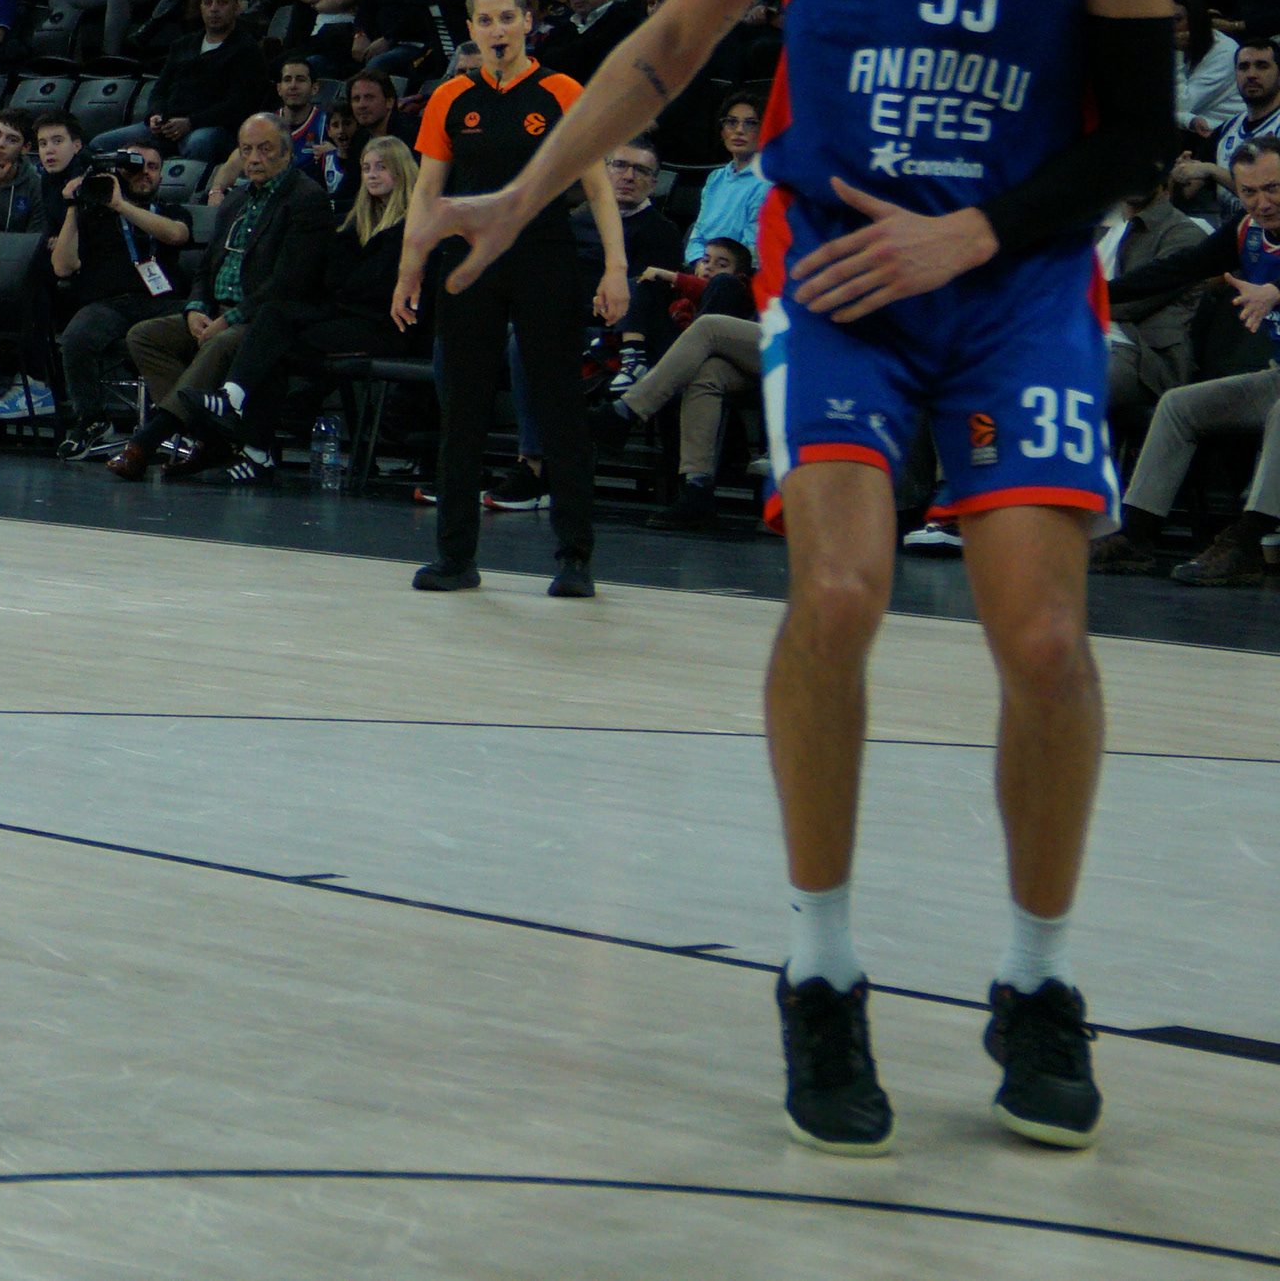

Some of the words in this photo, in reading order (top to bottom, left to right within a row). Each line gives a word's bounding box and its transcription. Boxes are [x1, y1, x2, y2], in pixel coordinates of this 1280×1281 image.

[848, 46, 1032, 112] ANADOLU
[869, 93, 996, 142] EFES
[1018, 385, 1095, 465] 35
